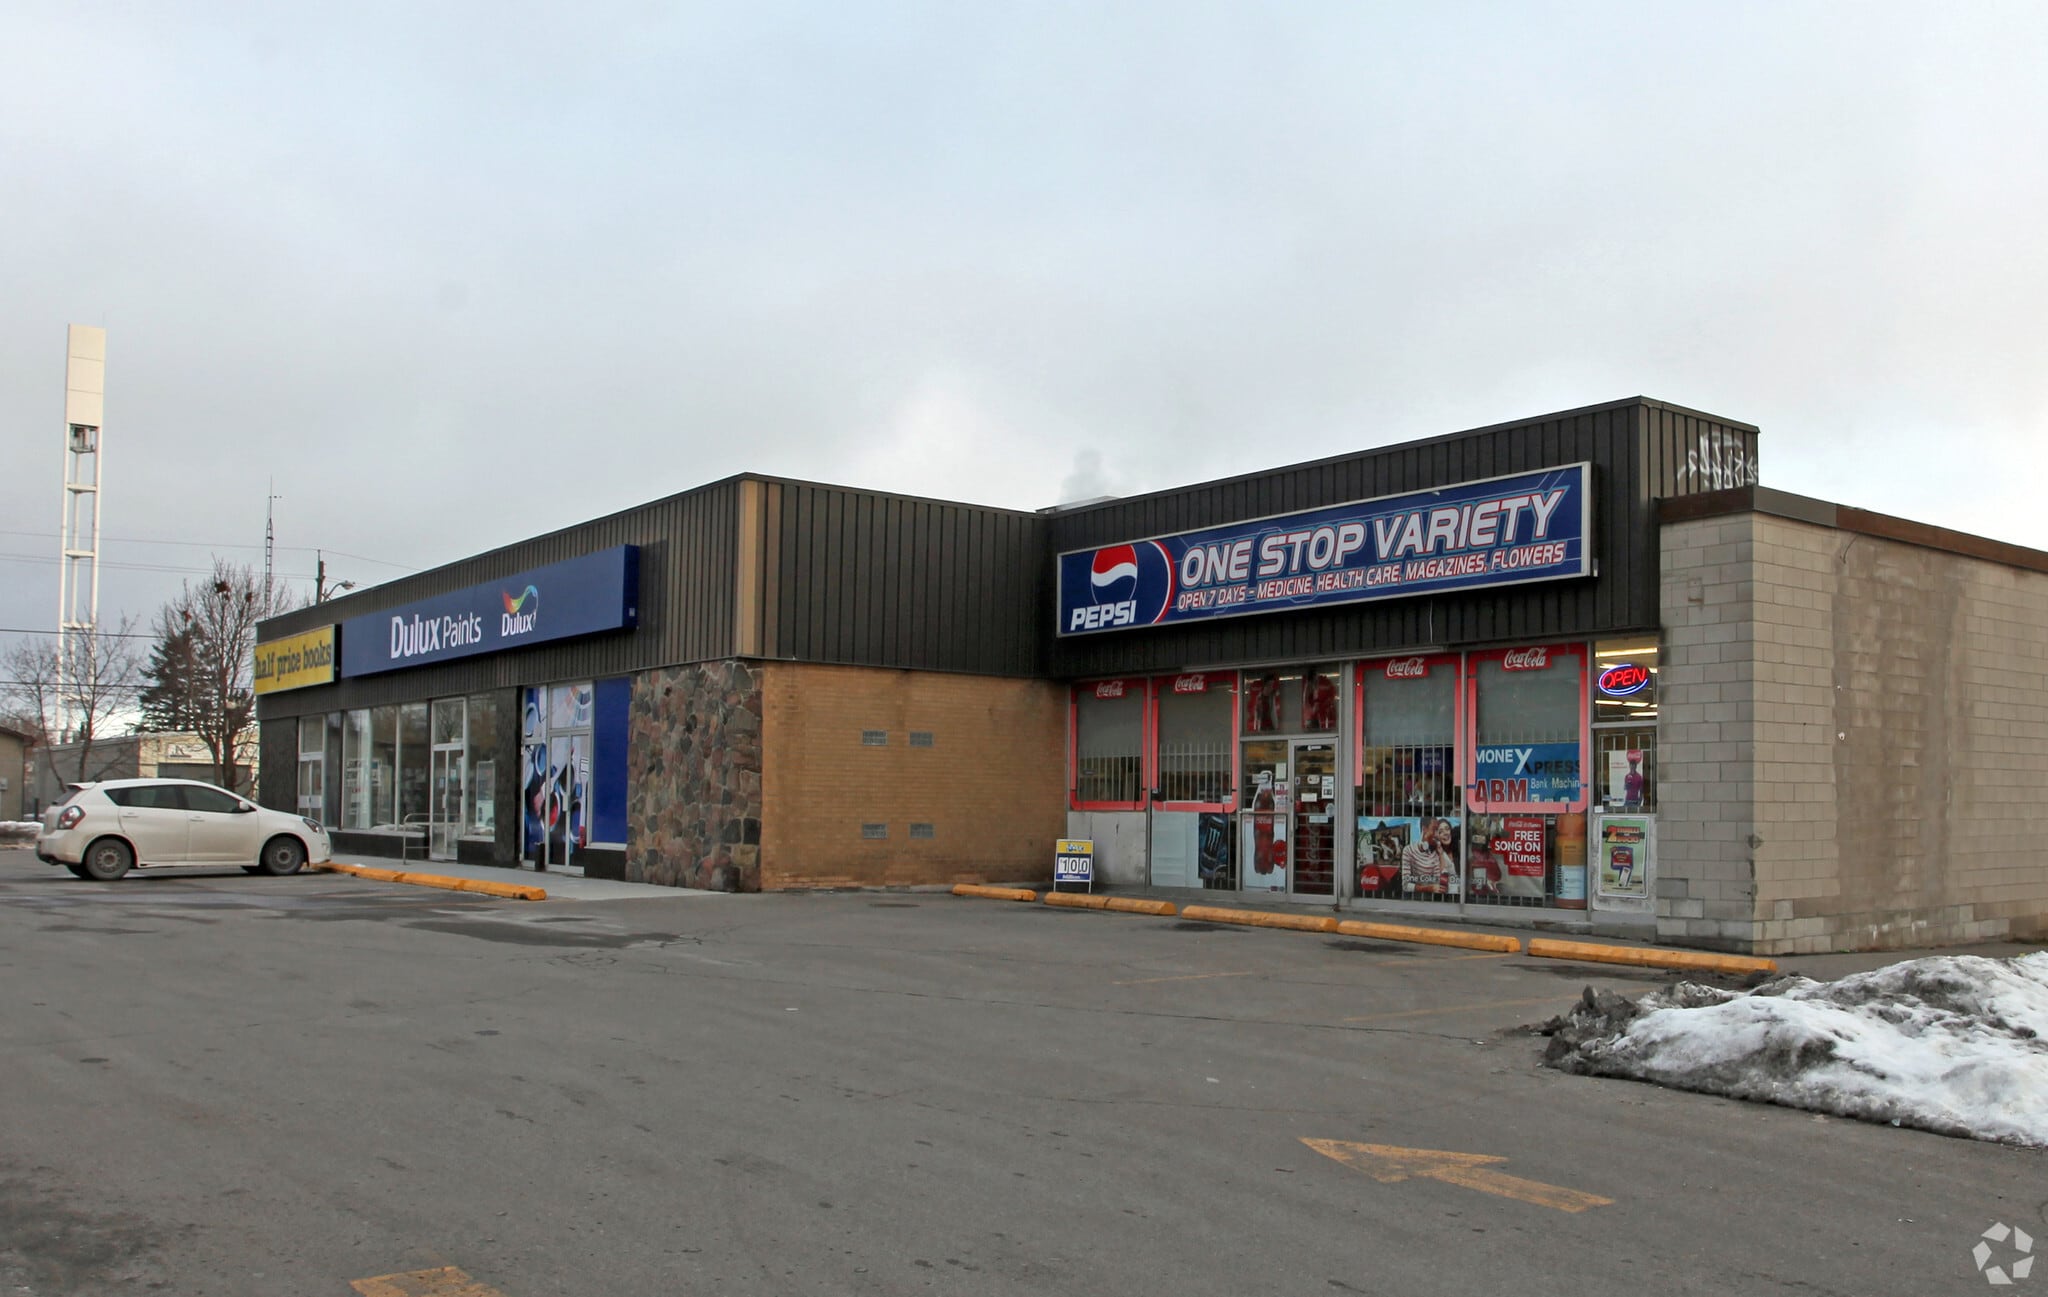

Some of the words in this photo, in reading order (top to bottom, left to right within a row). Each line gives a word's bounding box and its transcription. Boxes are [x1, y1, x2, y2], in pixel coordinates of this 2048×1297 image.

[1181, 539, 1252, 586] ONE
[1258, 522, 1366, 576] STOP
[1373, 489, 1566, 560] VARIETY
[1178, 591, 1207, 610] OPEN
[1207, 589, 1217, 606] 7
[1217, 585, 1246, 605] DAYS
[1257, 576, 1313, 599] MEDICINE,
[1316, 570, 1363, 592] HEALTH
[1366, 565, 1401, 587] CARE,
[1405, 553, 1488, 581] MAGAZINES,
[1491, 543, 1566, 570] FLOWERS
[501, 612, 535, 637] Dulux
[1070, 600, 1137, 631] PEPSI
[390, 613, 441, 659] Dulux
[442, 612, 482, 649] Paints
[255, 651, 275, 680] half
[277, 646, 301, 682] price
[302, 639, 332, 670] books
[1601, 666, 1647, 689] OPEN
[1475, 778, 1528, 803] ABM
[1531, 777, 1548, 789] Bank
[1552, 777, 1580, 789] Machin
[1494, 841, 1522, 852] SONG
[1524, 842, 1541, 852] ON
[1514, 831, 1541, 841] FREE
[1509, 852, 1541, 863] iTunes
